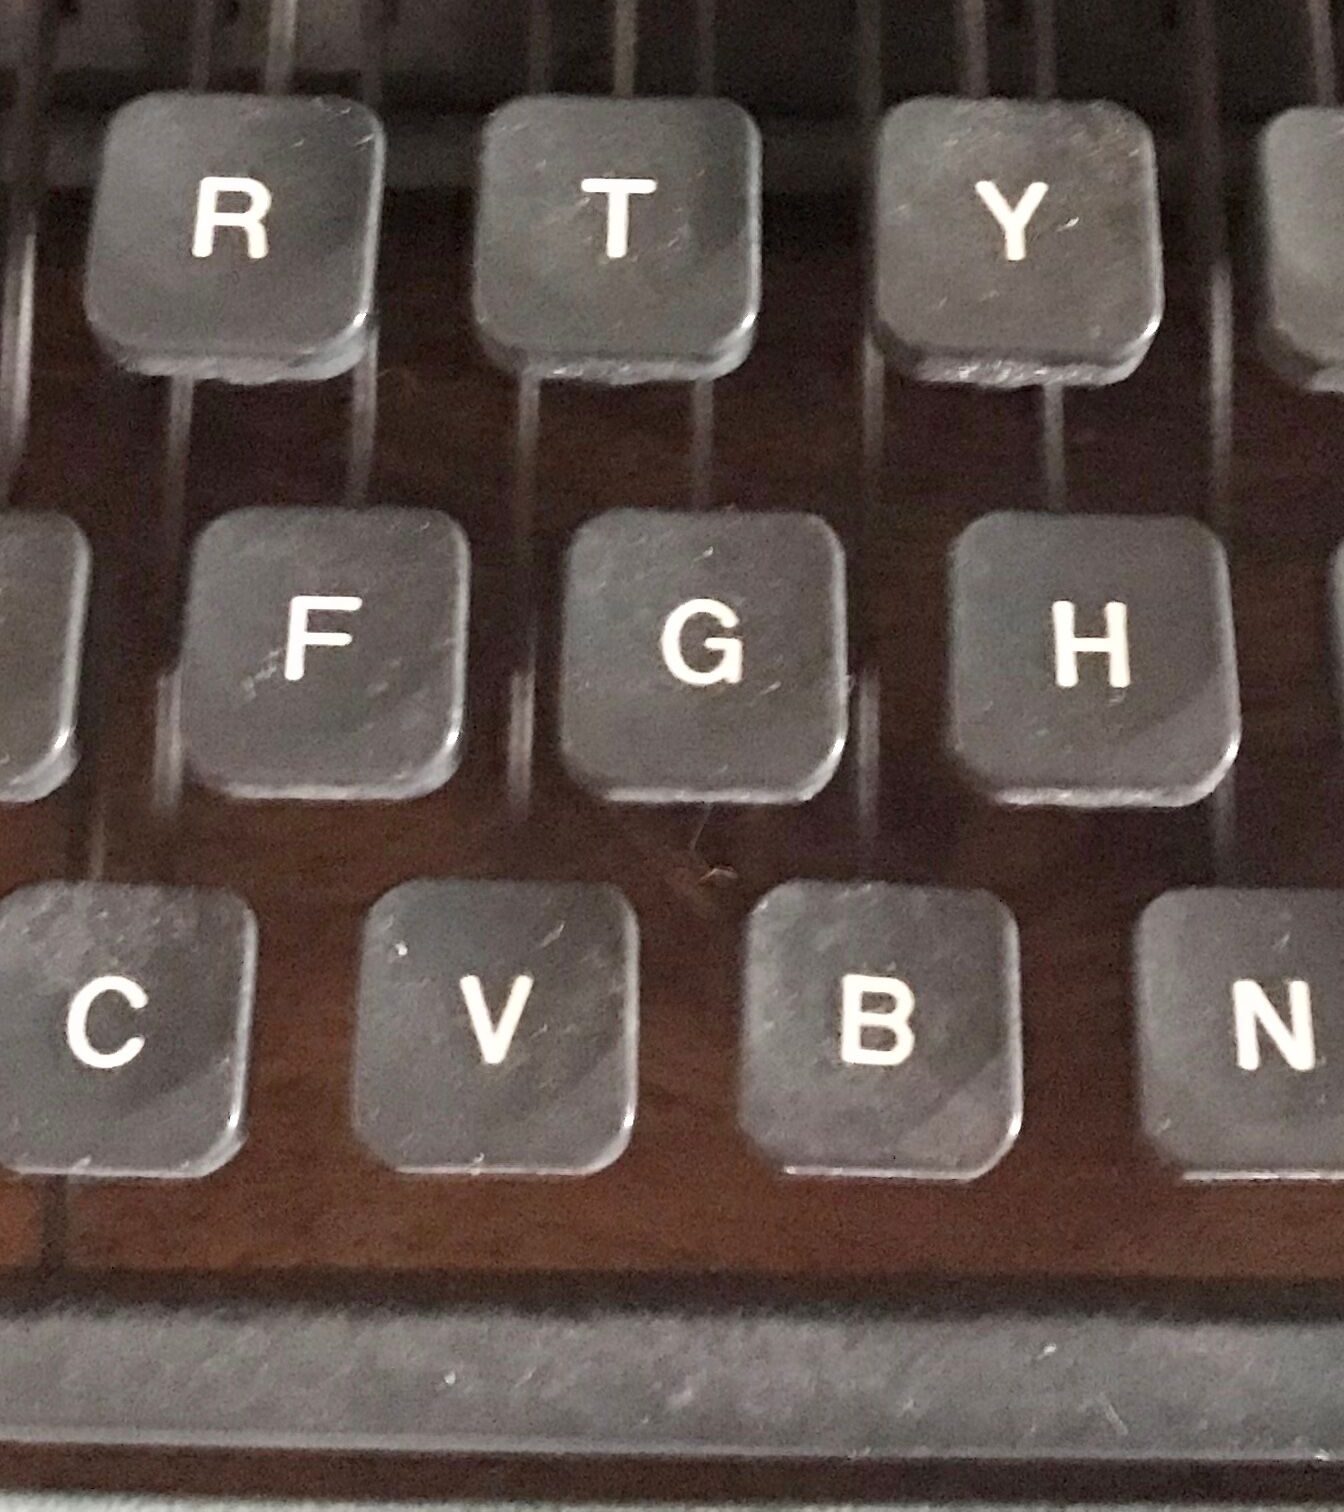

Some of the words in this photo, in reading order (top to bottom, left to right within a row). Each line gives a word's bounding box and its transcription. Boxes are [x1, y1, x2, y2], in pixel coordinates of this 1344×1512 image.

[190, 175, 273, 260] R
[579, 176, 658, 260] T
[973, 179, 1050, 262] Y
[283, 594, 364, 682] F
[659, 597, 744, 687] G
[1050, 599, 1132, 689] H
[65, 974, 149, 1070] C
[458, 973, 534, 1066] V
[839, 972, 916, 1067] B
[1231, 978, 1316, 1072] N
